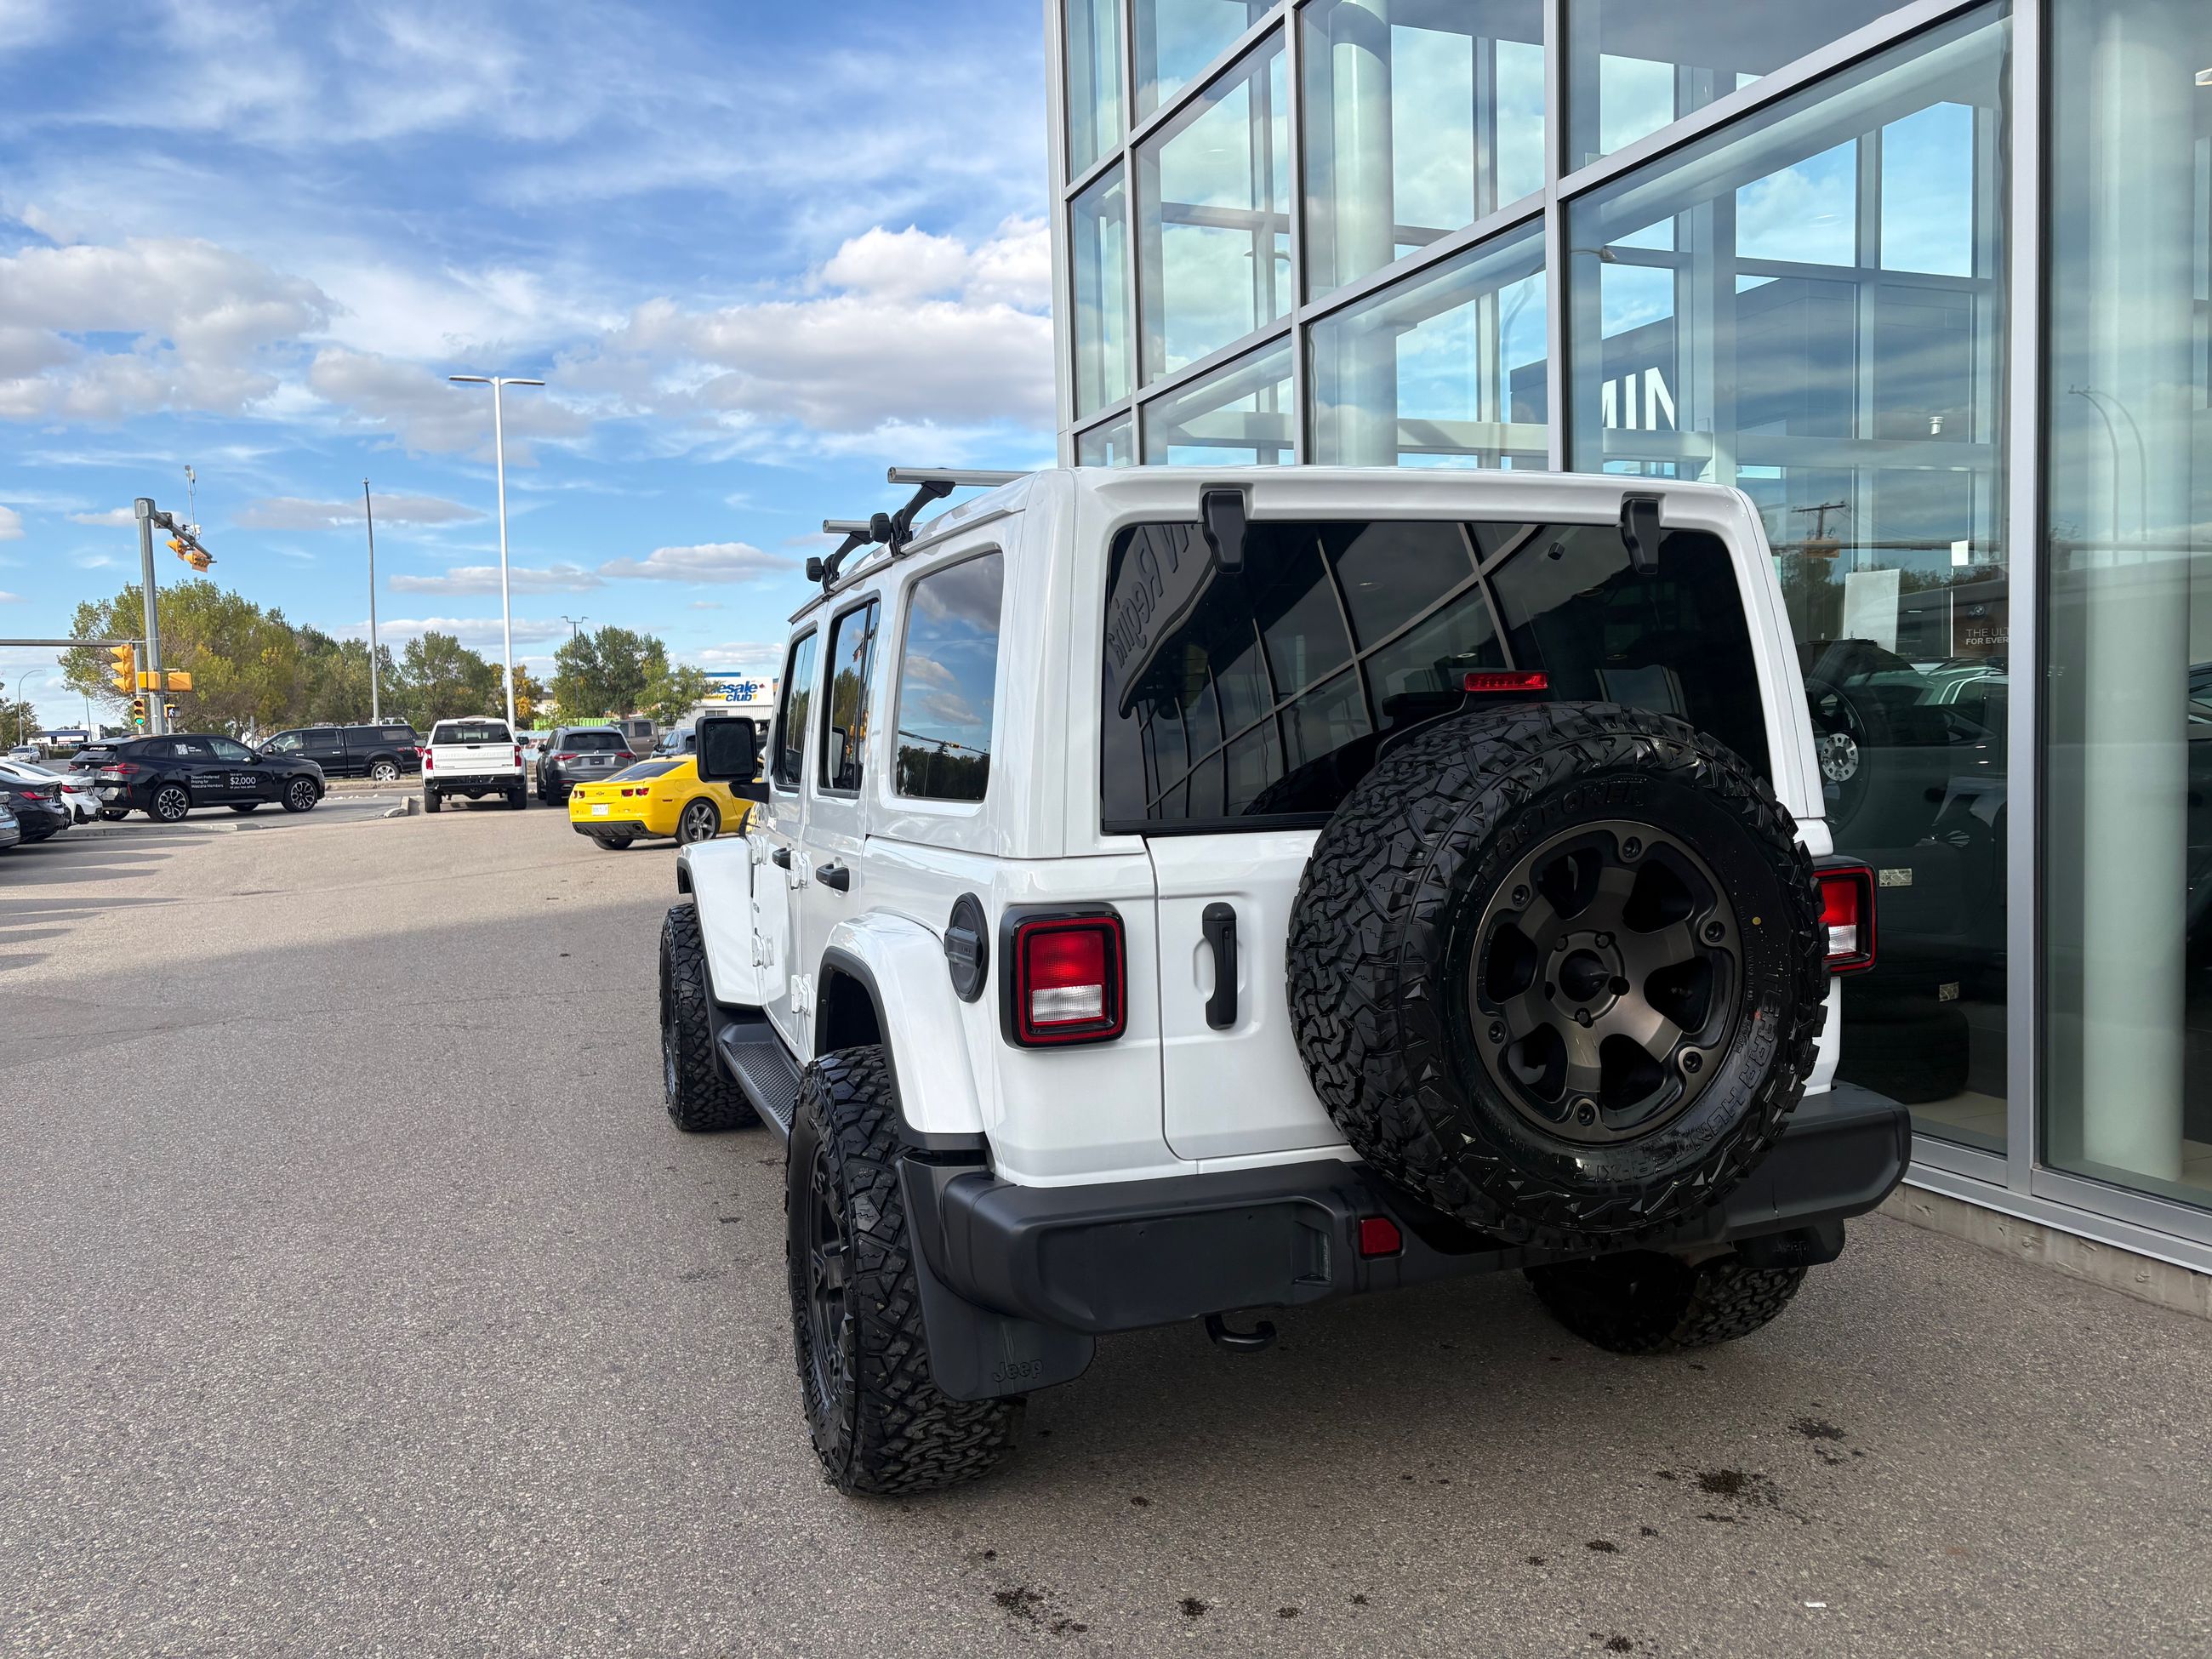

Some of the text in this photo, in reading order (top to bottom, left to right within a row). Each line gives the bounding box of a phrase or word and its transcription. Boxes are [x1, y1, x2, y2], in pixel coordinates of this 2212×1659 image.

[1966, 628, 1988, 637] THE
[726, 691, 753, 702] club
[230, 777, 256, 785] $2,000
[993, 1359, 1043, 1382] Jeep
